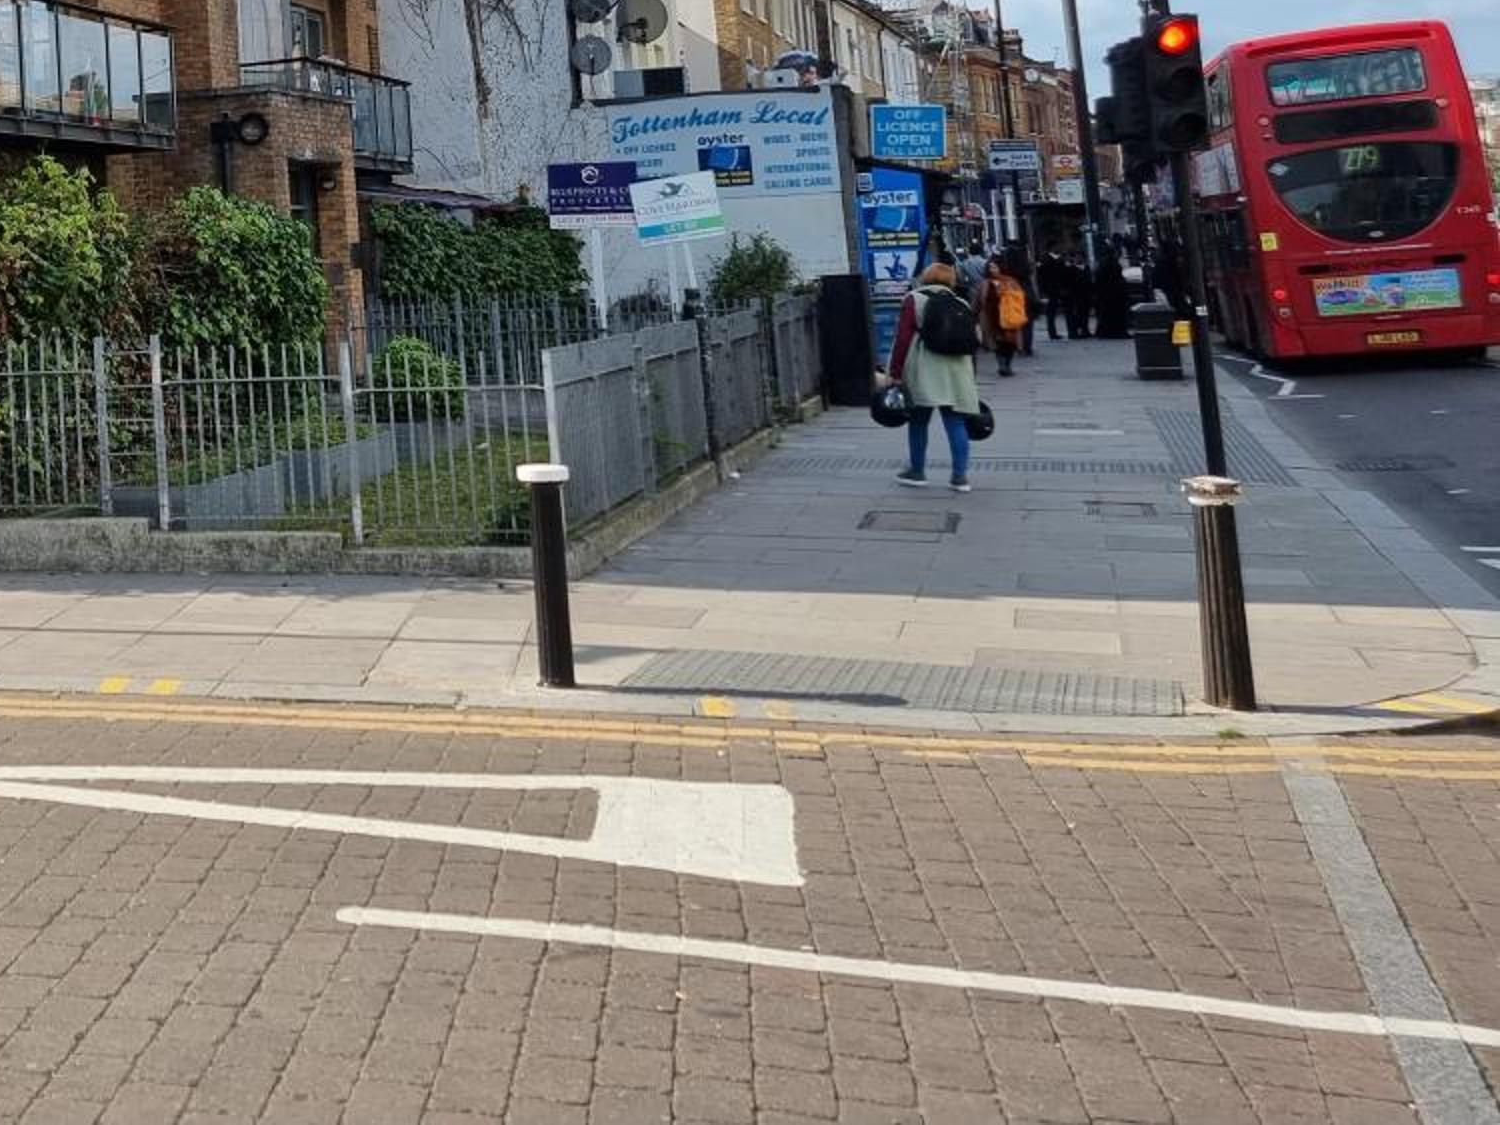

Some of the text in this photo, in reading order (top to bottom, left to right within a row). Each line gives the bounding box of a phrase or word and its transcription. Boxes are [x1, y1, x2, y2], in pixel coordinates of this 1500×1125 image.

[893, 110, 922, 120] OFF
[612, 100, 829, 144] Tottenham Local
[876, 121, 939, 132] LICENCE
[697, 131, 745, 147] oyster
[887, 134, 931, 146] OPEN
[907, 146, 936, 156] LATE
[763, 162, 832, 173] INTERNATIONAL
[863, 192, 913, 205] oyster
